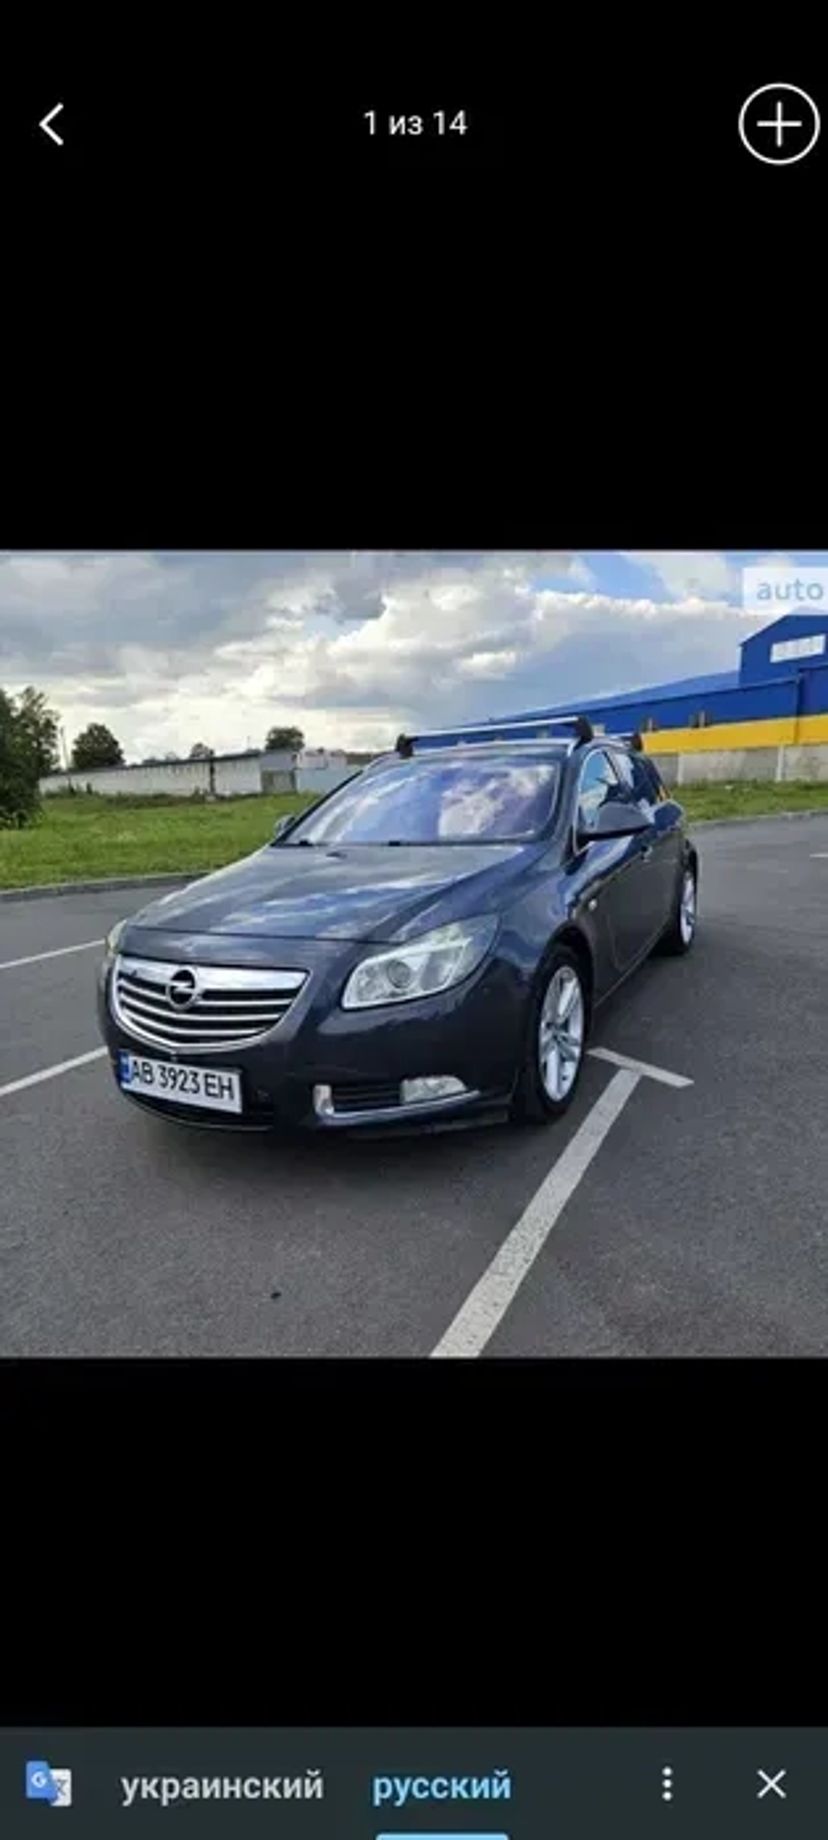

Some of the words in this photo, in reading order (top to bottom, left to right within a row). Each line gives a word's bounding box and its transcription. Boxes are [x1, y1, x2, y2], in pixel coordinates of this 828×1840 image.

[131, 1060, 155, 1085] AB
[158, 1064, 200, 1094] 3923
[204, 1072, 235, 1100] EH
